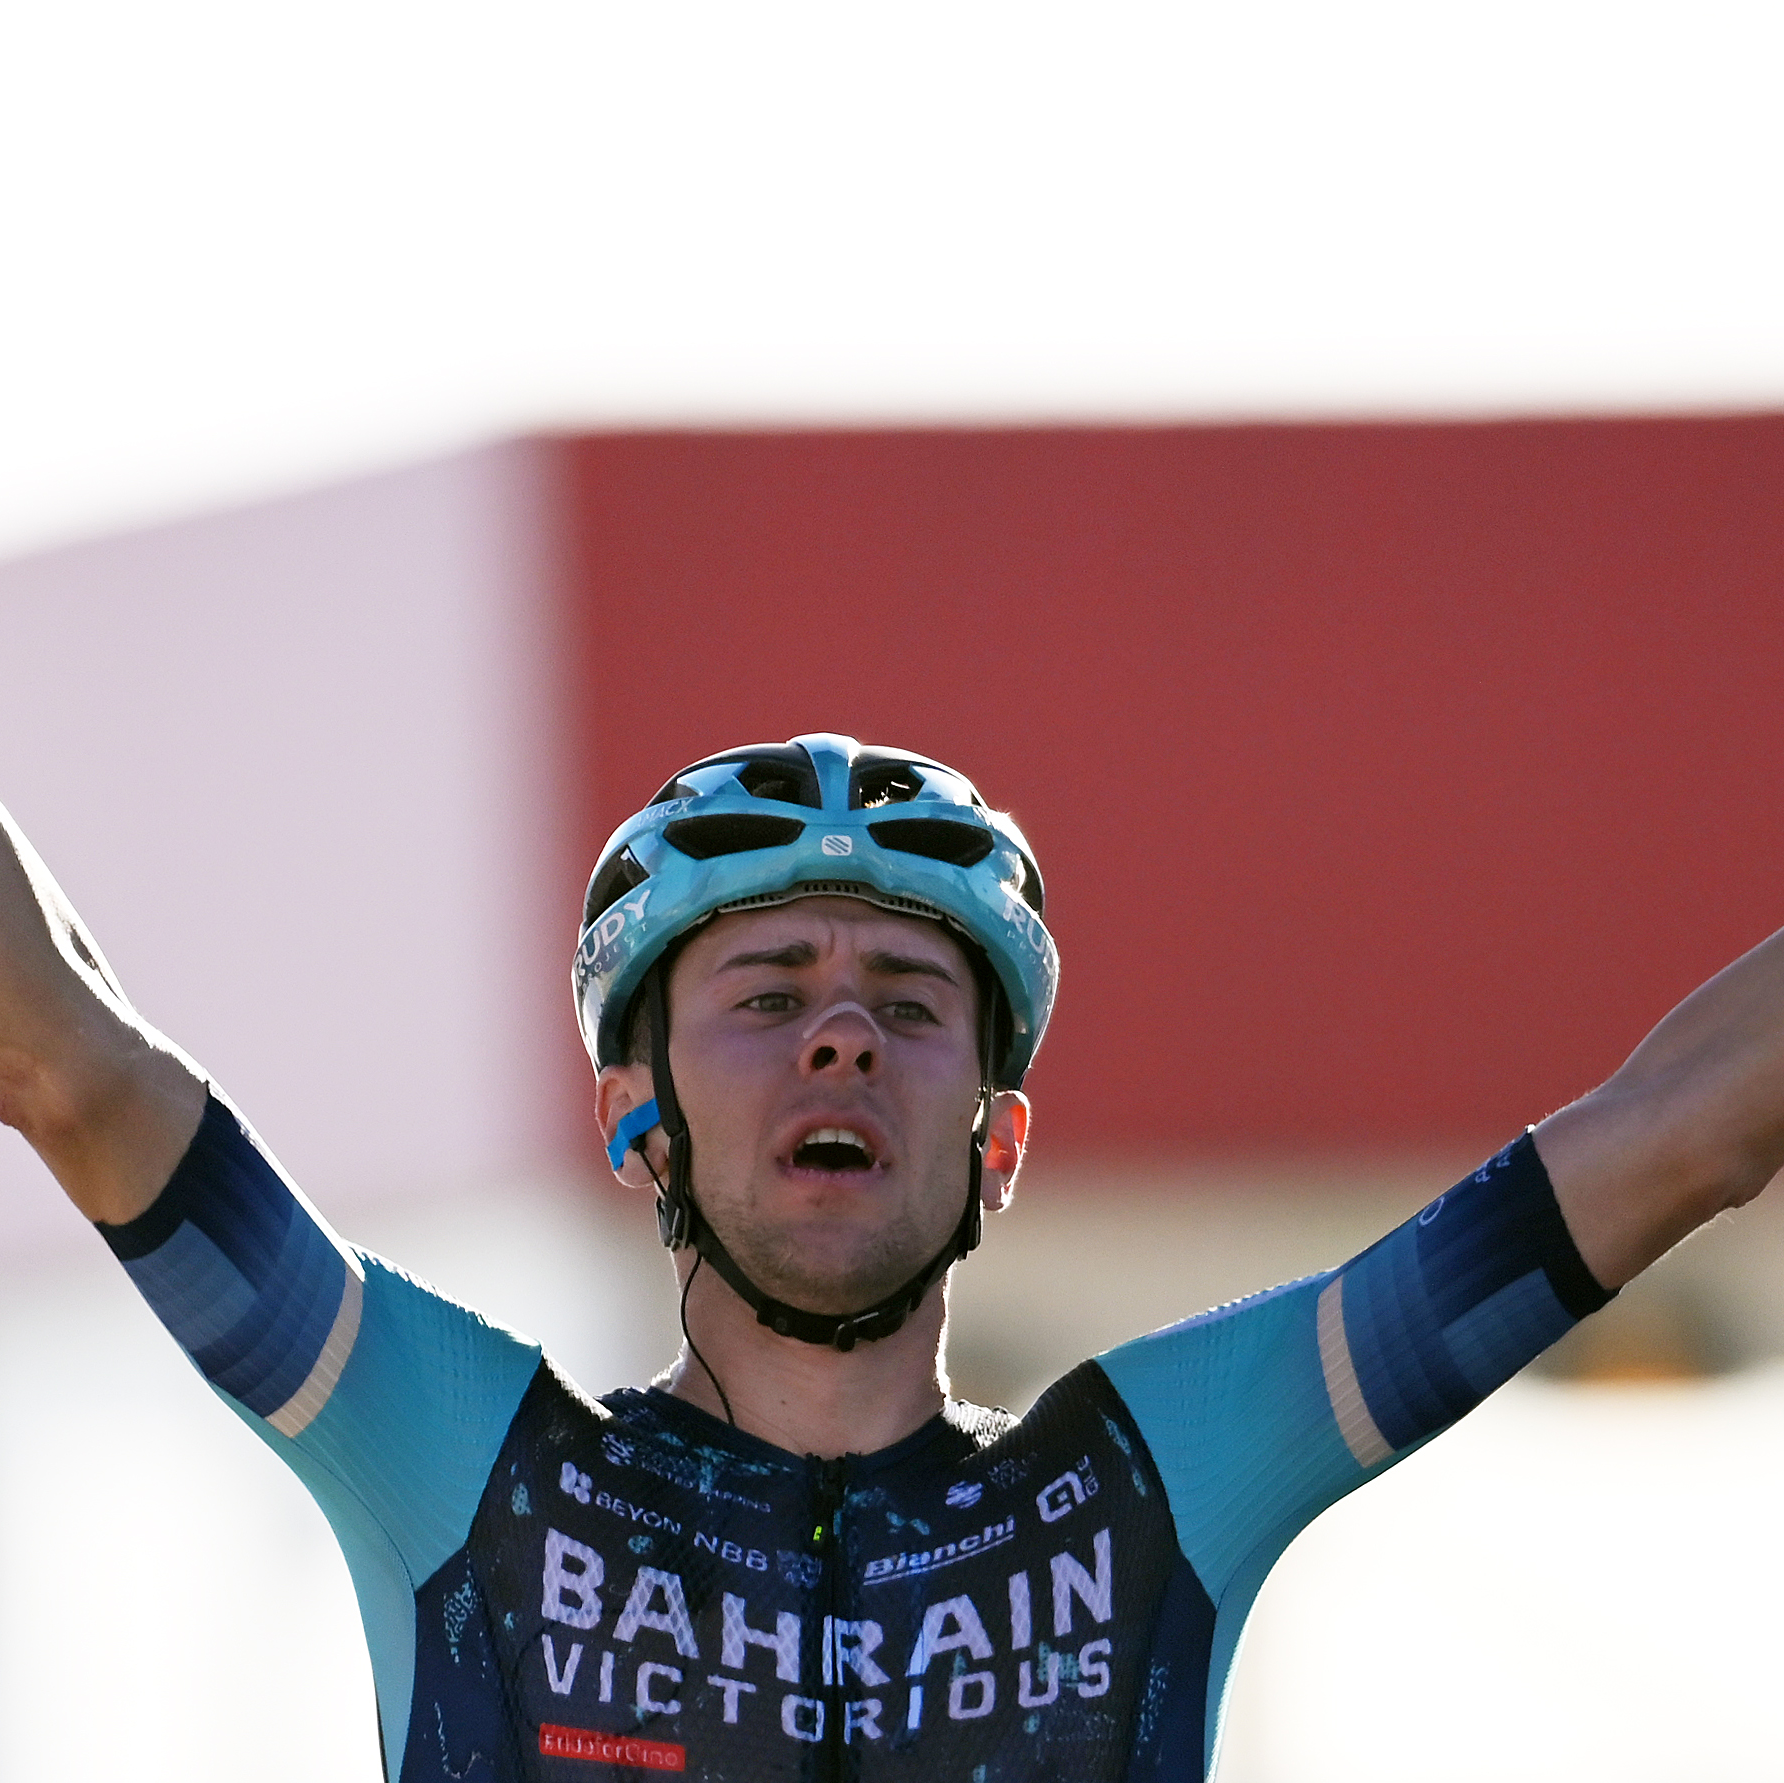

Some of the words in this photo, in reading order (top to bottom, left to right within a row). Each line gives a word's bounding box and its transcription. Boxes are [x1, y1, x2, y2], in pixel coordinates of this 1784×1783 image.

[595, 1491, 682, 1536] BEYON
[693, 1531, 768, 1572] NBB
[864, 1514, 1015, 1579] Bianchi
[539, 1527, 1112, 1687] BAHRAIN
[540, 1634, 1113, 1744] VICTORIOUS
